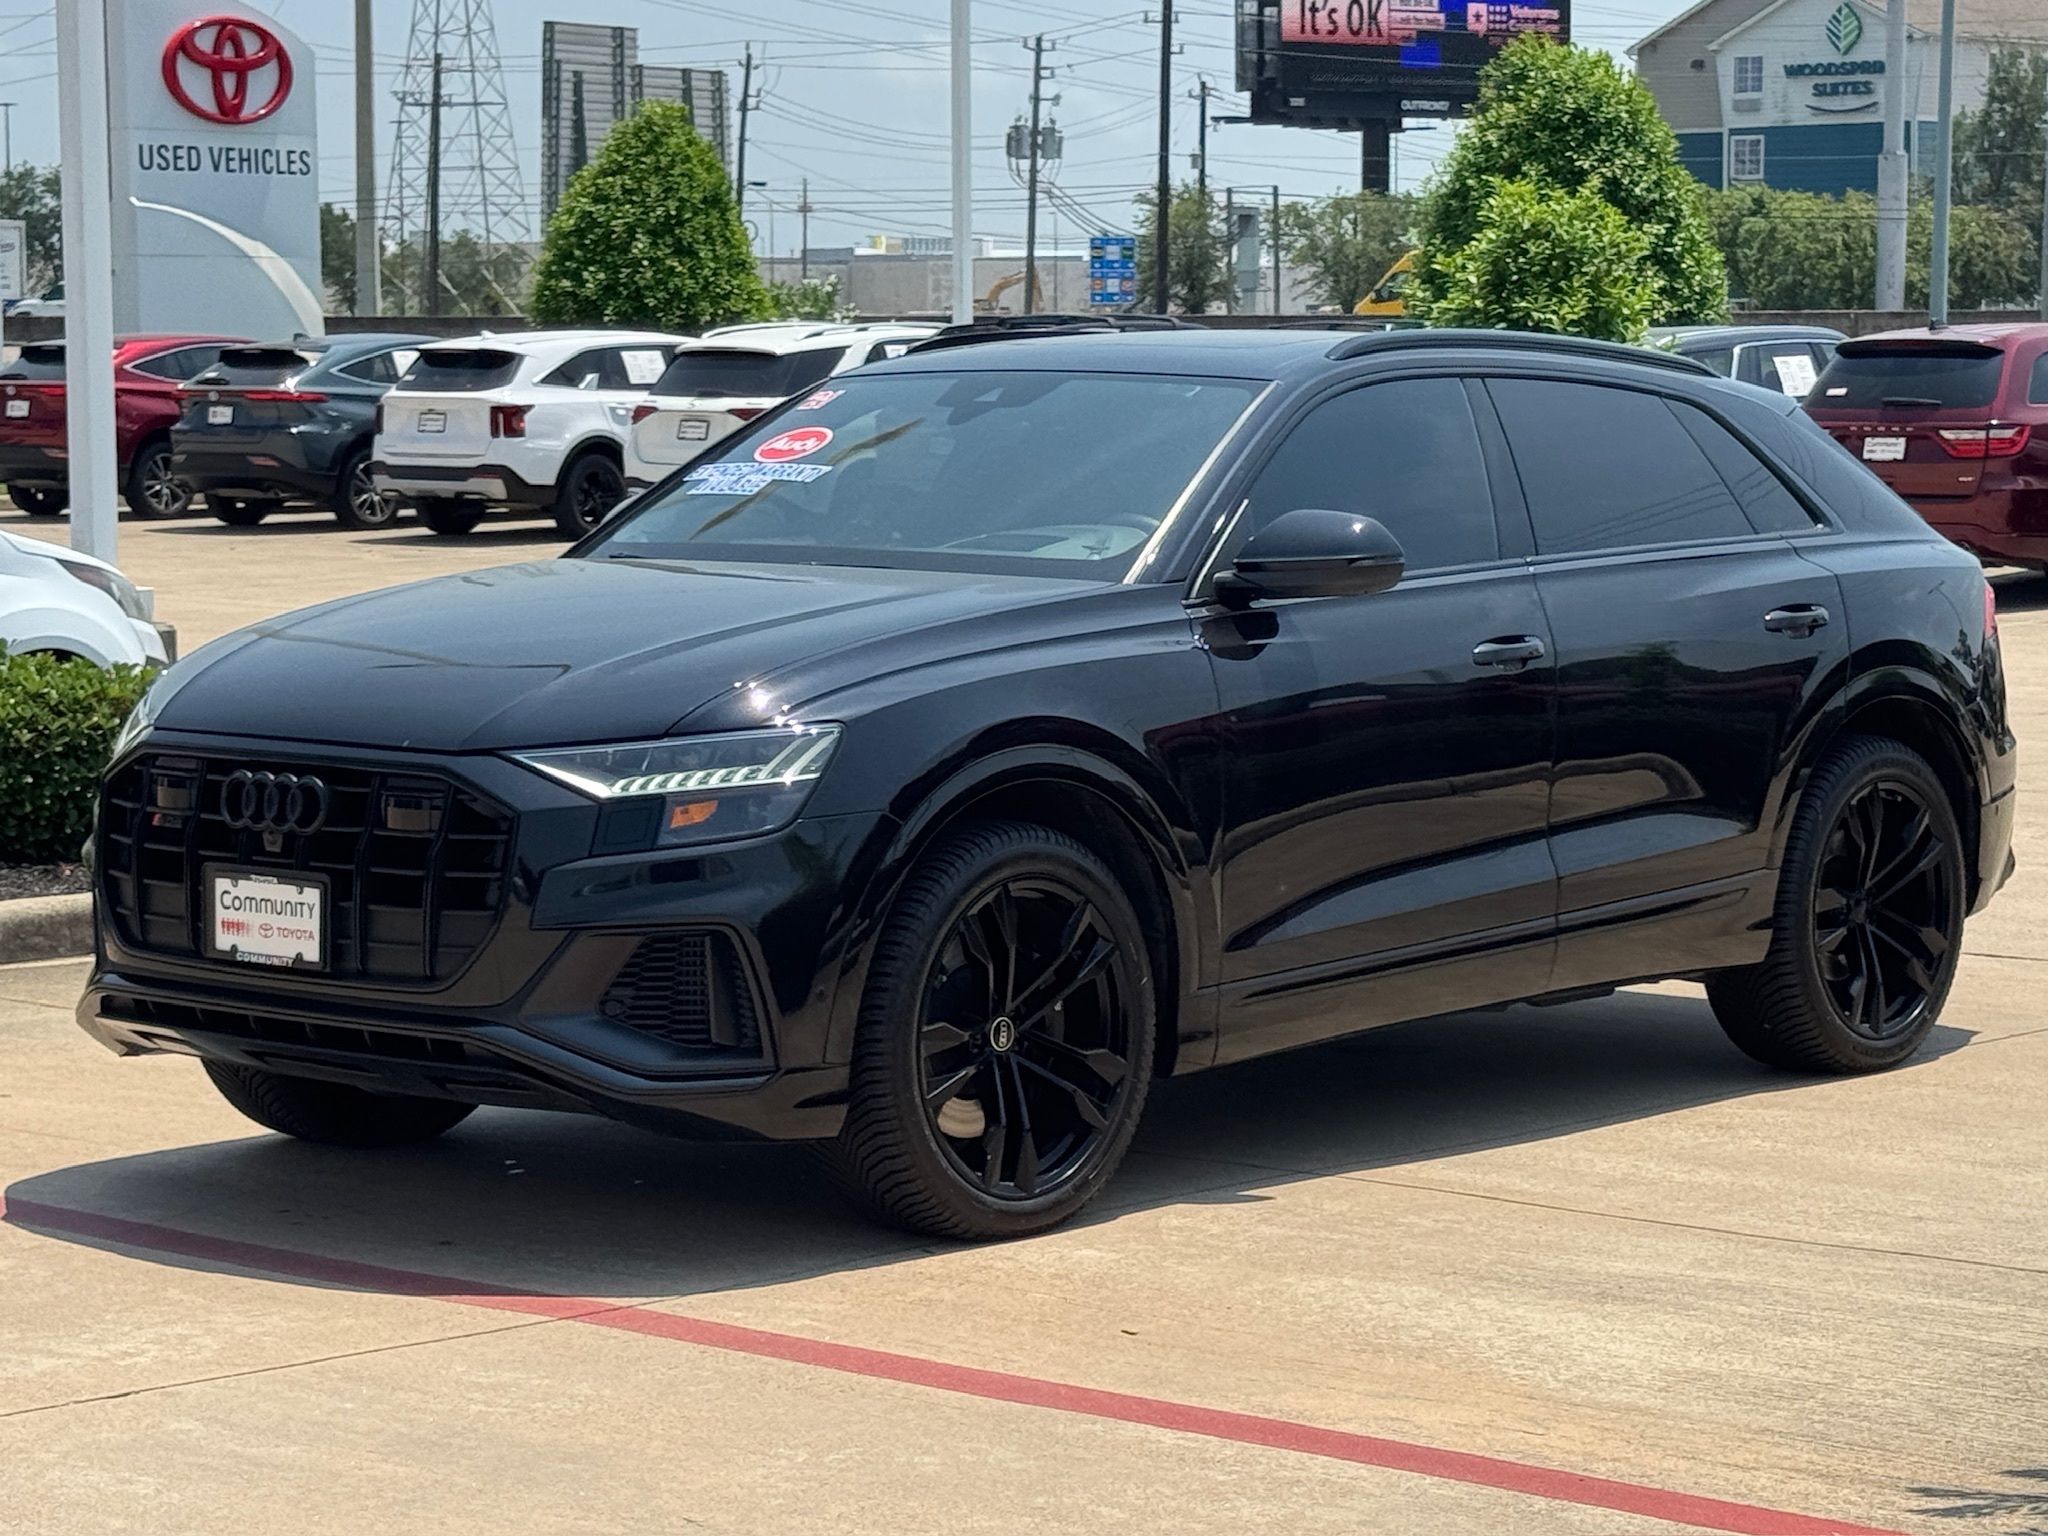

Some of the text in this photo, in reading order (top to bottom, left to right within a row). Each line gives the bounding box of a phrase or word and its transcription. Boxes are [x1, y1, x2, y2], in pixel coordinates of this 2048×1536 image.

[1299, 0, 1384, 37] It's OK
[1783, 60, 1886, 77] WOODSPRIN
[1812, 80, 1874, 97] SUITES
[138, 144, 312, 176] USED VEHICLES
[276, 927, 316, 942] TOYOTA
[236, 951, 293, 967] COMMUNITY
